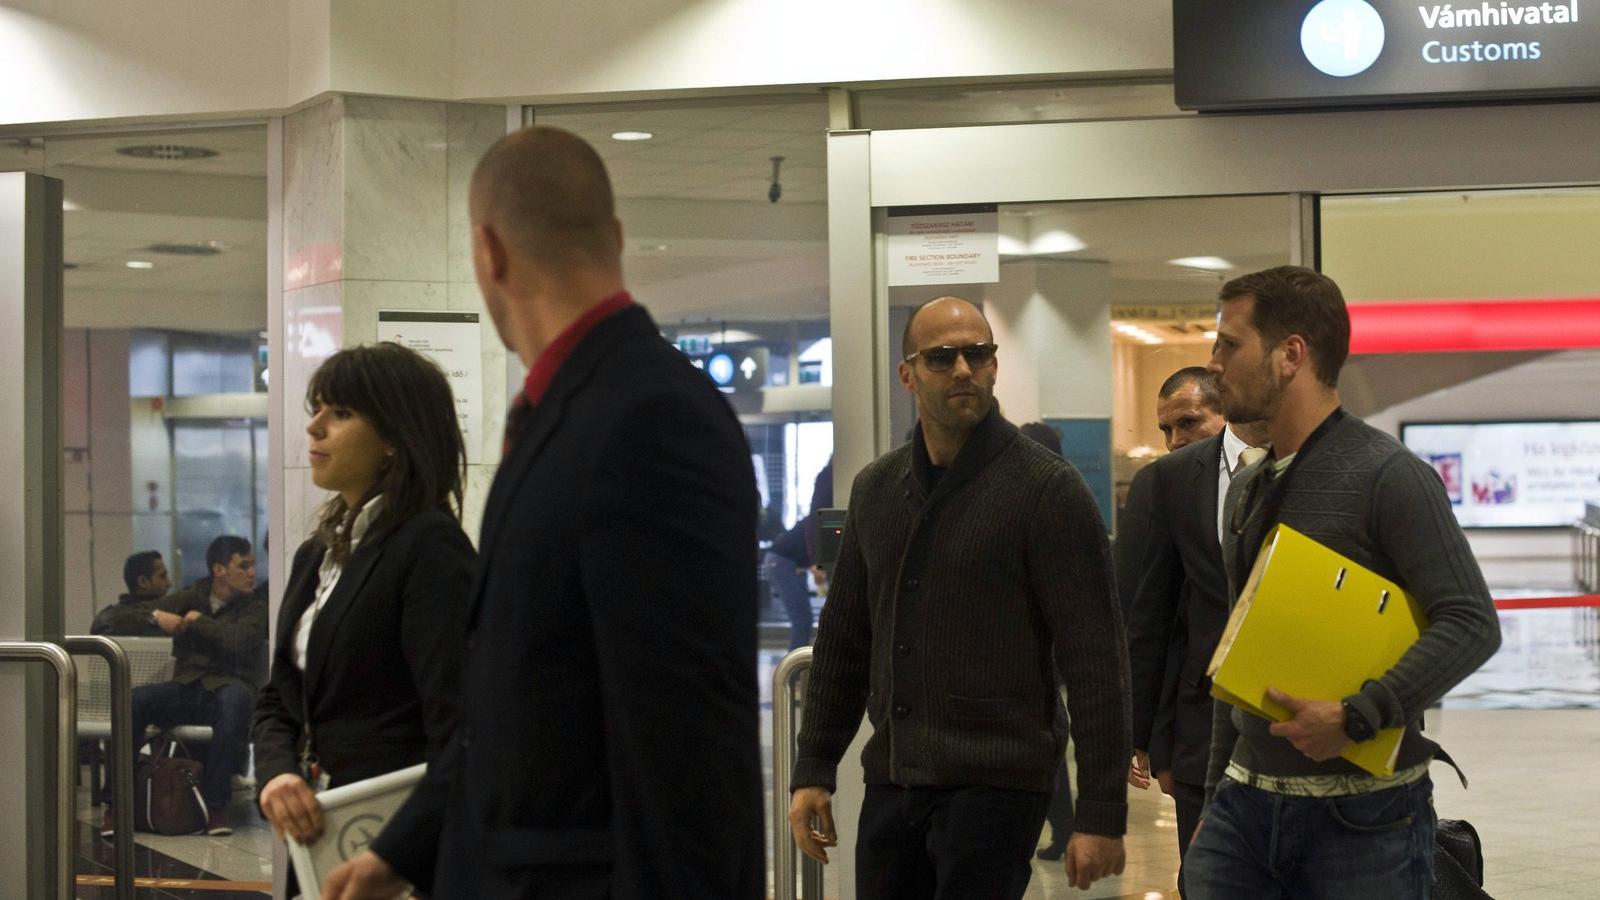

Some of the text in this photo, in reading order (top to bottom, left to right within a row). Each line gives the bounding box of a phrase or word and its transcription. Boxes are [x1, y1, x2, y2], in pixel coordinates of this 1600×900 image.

[1418, 0, 1578, 28] Vámhivatal
[1422, 41, 1541, 63] Customs
[947, 252, 981, 260] BOUNDARY
